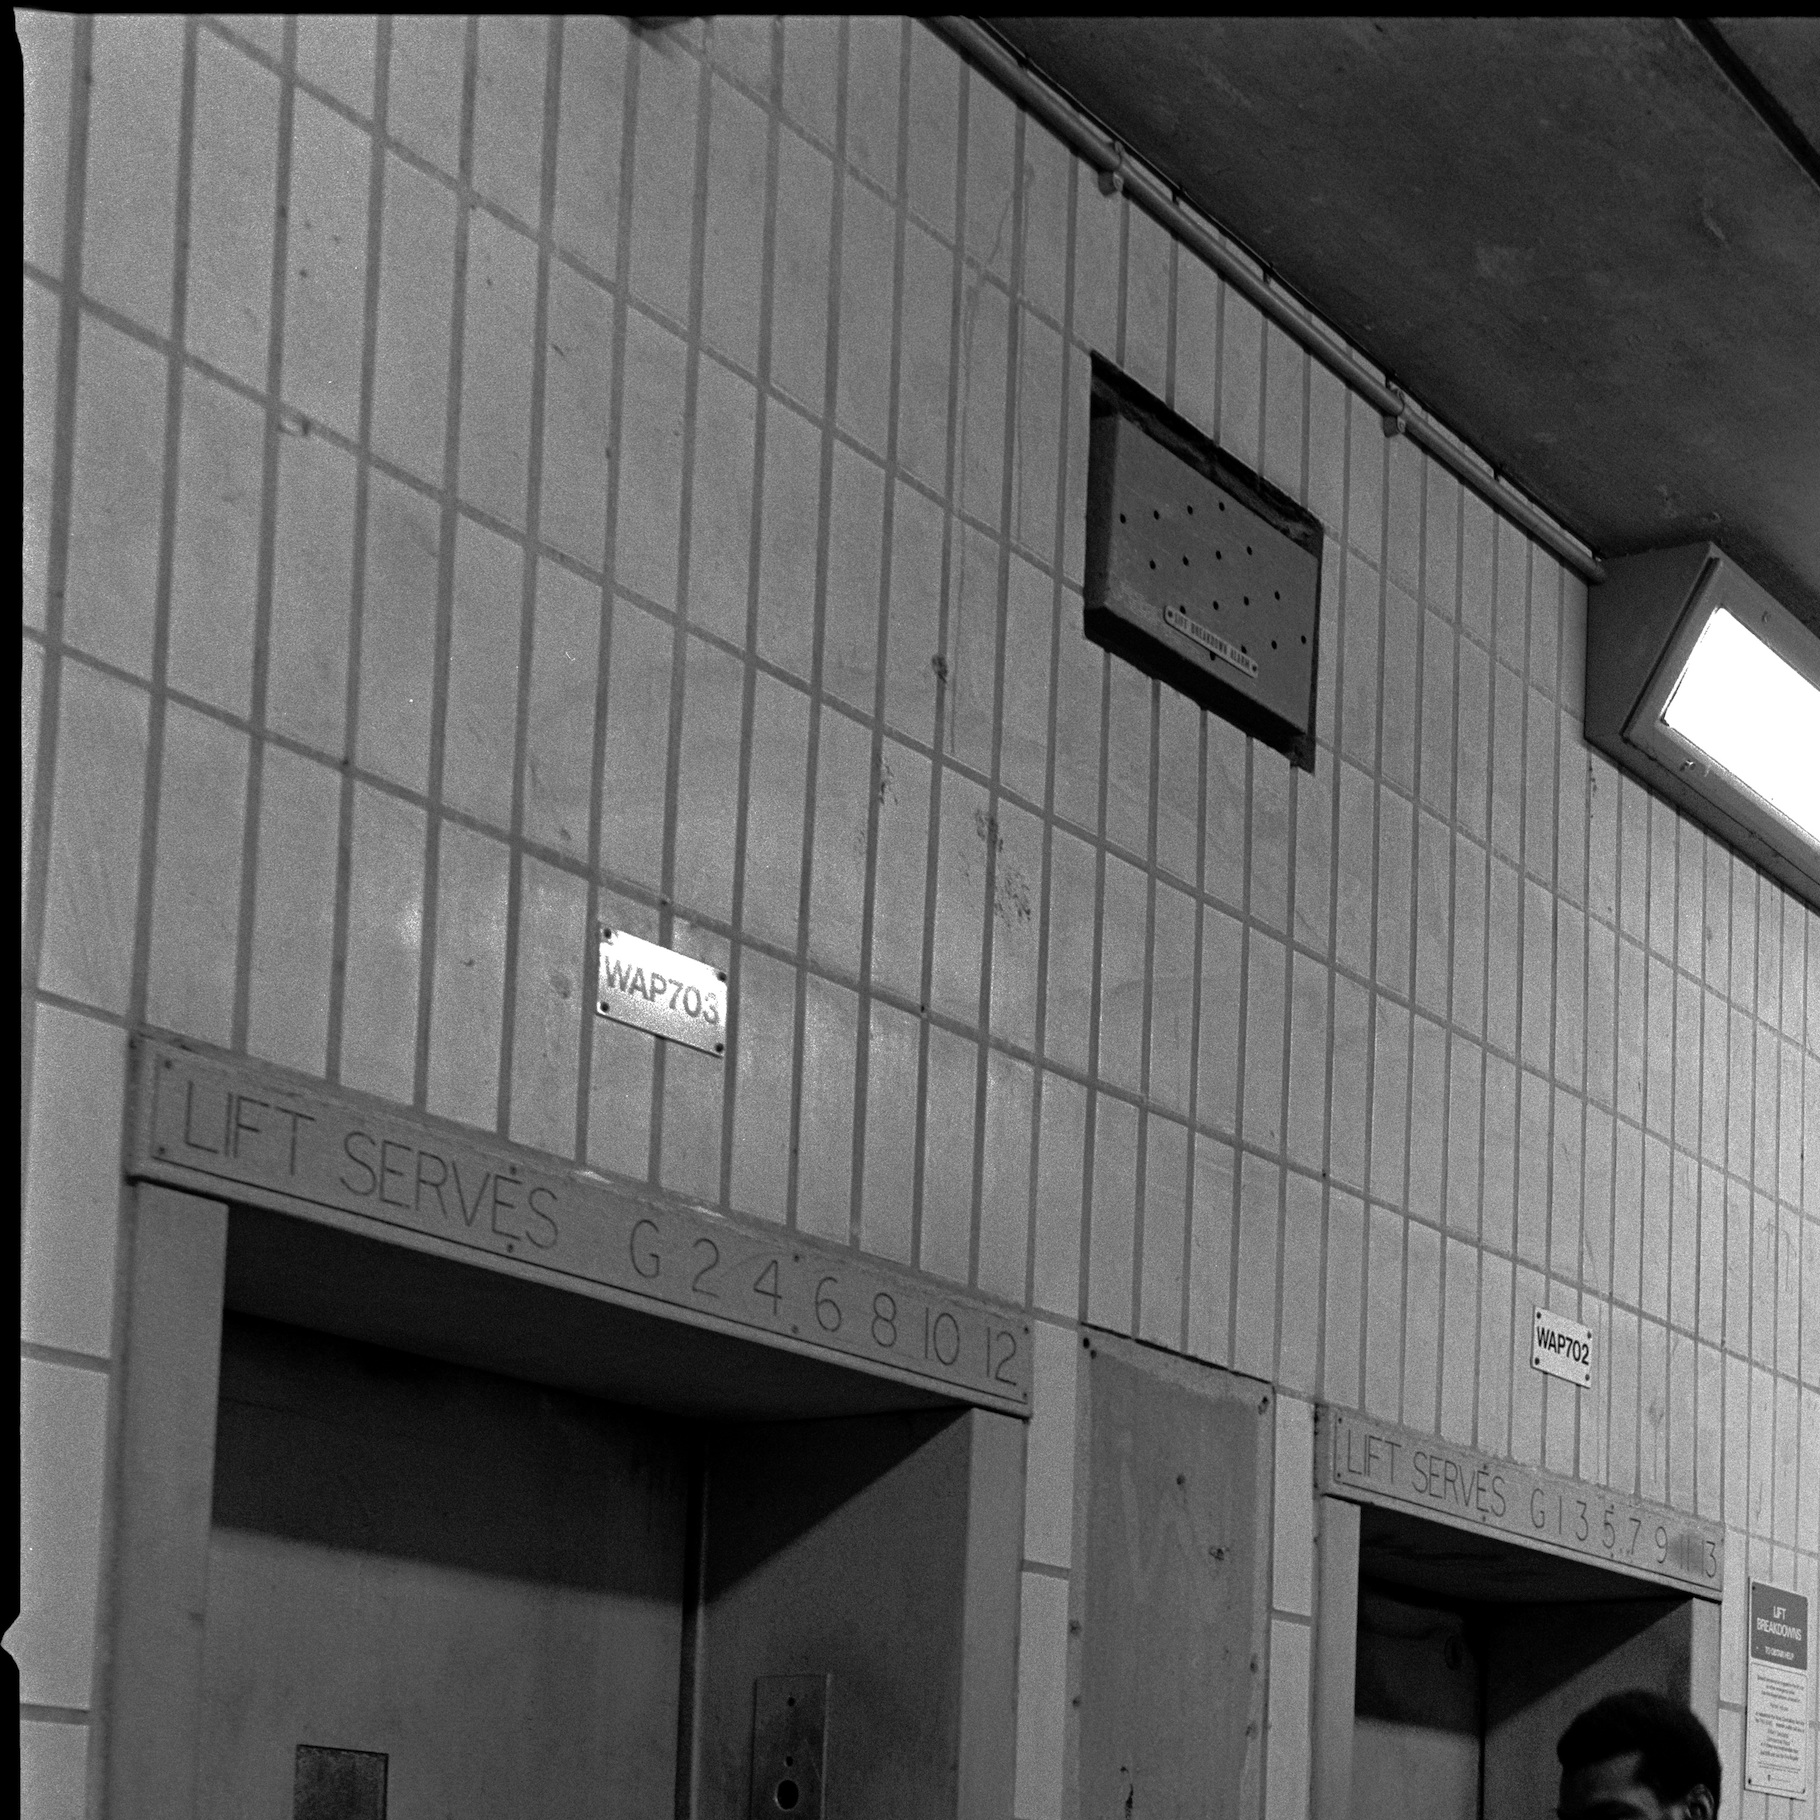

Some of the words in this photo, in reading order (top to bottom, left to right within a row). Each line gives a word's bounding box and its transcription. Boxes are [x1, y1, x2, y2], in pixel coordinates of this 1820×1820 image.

[603, 954, 721, 1027] WAP703
[182, 1080, 316, 1178] LIFT
[339, 1130, 559, 1250] SERVES
[629, 1218, 660, 1279] G
[692, 1237, 720, 1299] 2
[753, 1259, 783, 1316] 4
[815, 1276, 842, 1332] 6
[871, 1291, 898, 1348] 8
[924, 1306, 961, 1366] 10
[986, 1325, 1018, 1387] 12
[1536, 1326, 1590, 1367] WAP702
[1346, 1428, 1402, 1485] LIFT
[1412, 1450, 1507, 1519] SERVES
[1530, 1487, 1546, 1530] G
[1575, 1501, 1590, 1542] 3
[1601, 1509, 1617, 1550] 5
[1626, 1517, 1643, 1556] 7
[1654, 1525, 1669, 1565] 9
[1756, 1617, 1803, 1642] BREAKDOWNS
[1772, 1605, 1787, 1621] LIFT
